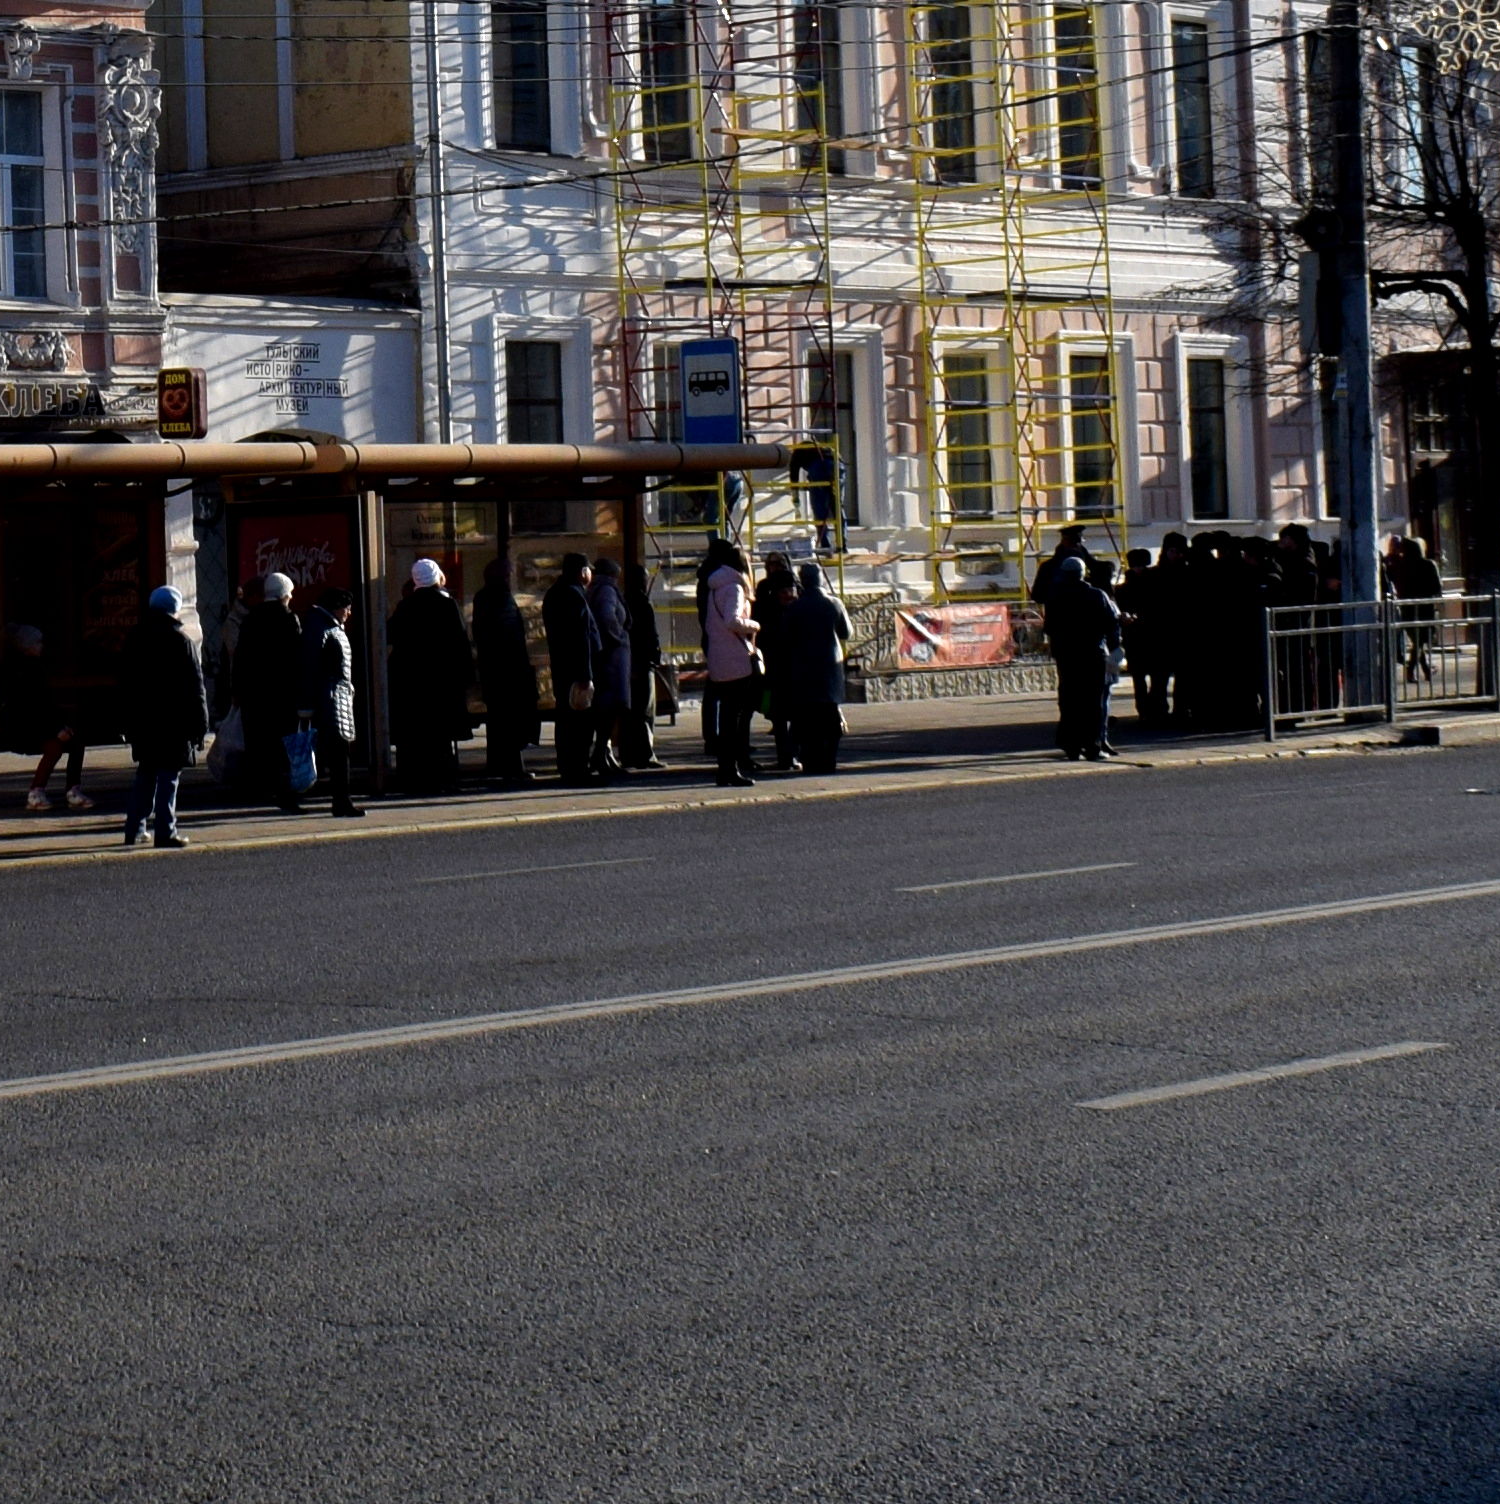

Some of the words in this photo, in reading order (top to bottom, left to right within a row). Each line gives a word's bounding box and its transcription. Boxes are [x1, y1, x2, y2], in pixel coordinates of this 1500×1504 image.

[165, 374, 186, 385] ДОМ
[275, 398, 310, 413] МУЗЕЙ
[162, 422, 192, 433] ХЛЕБА
